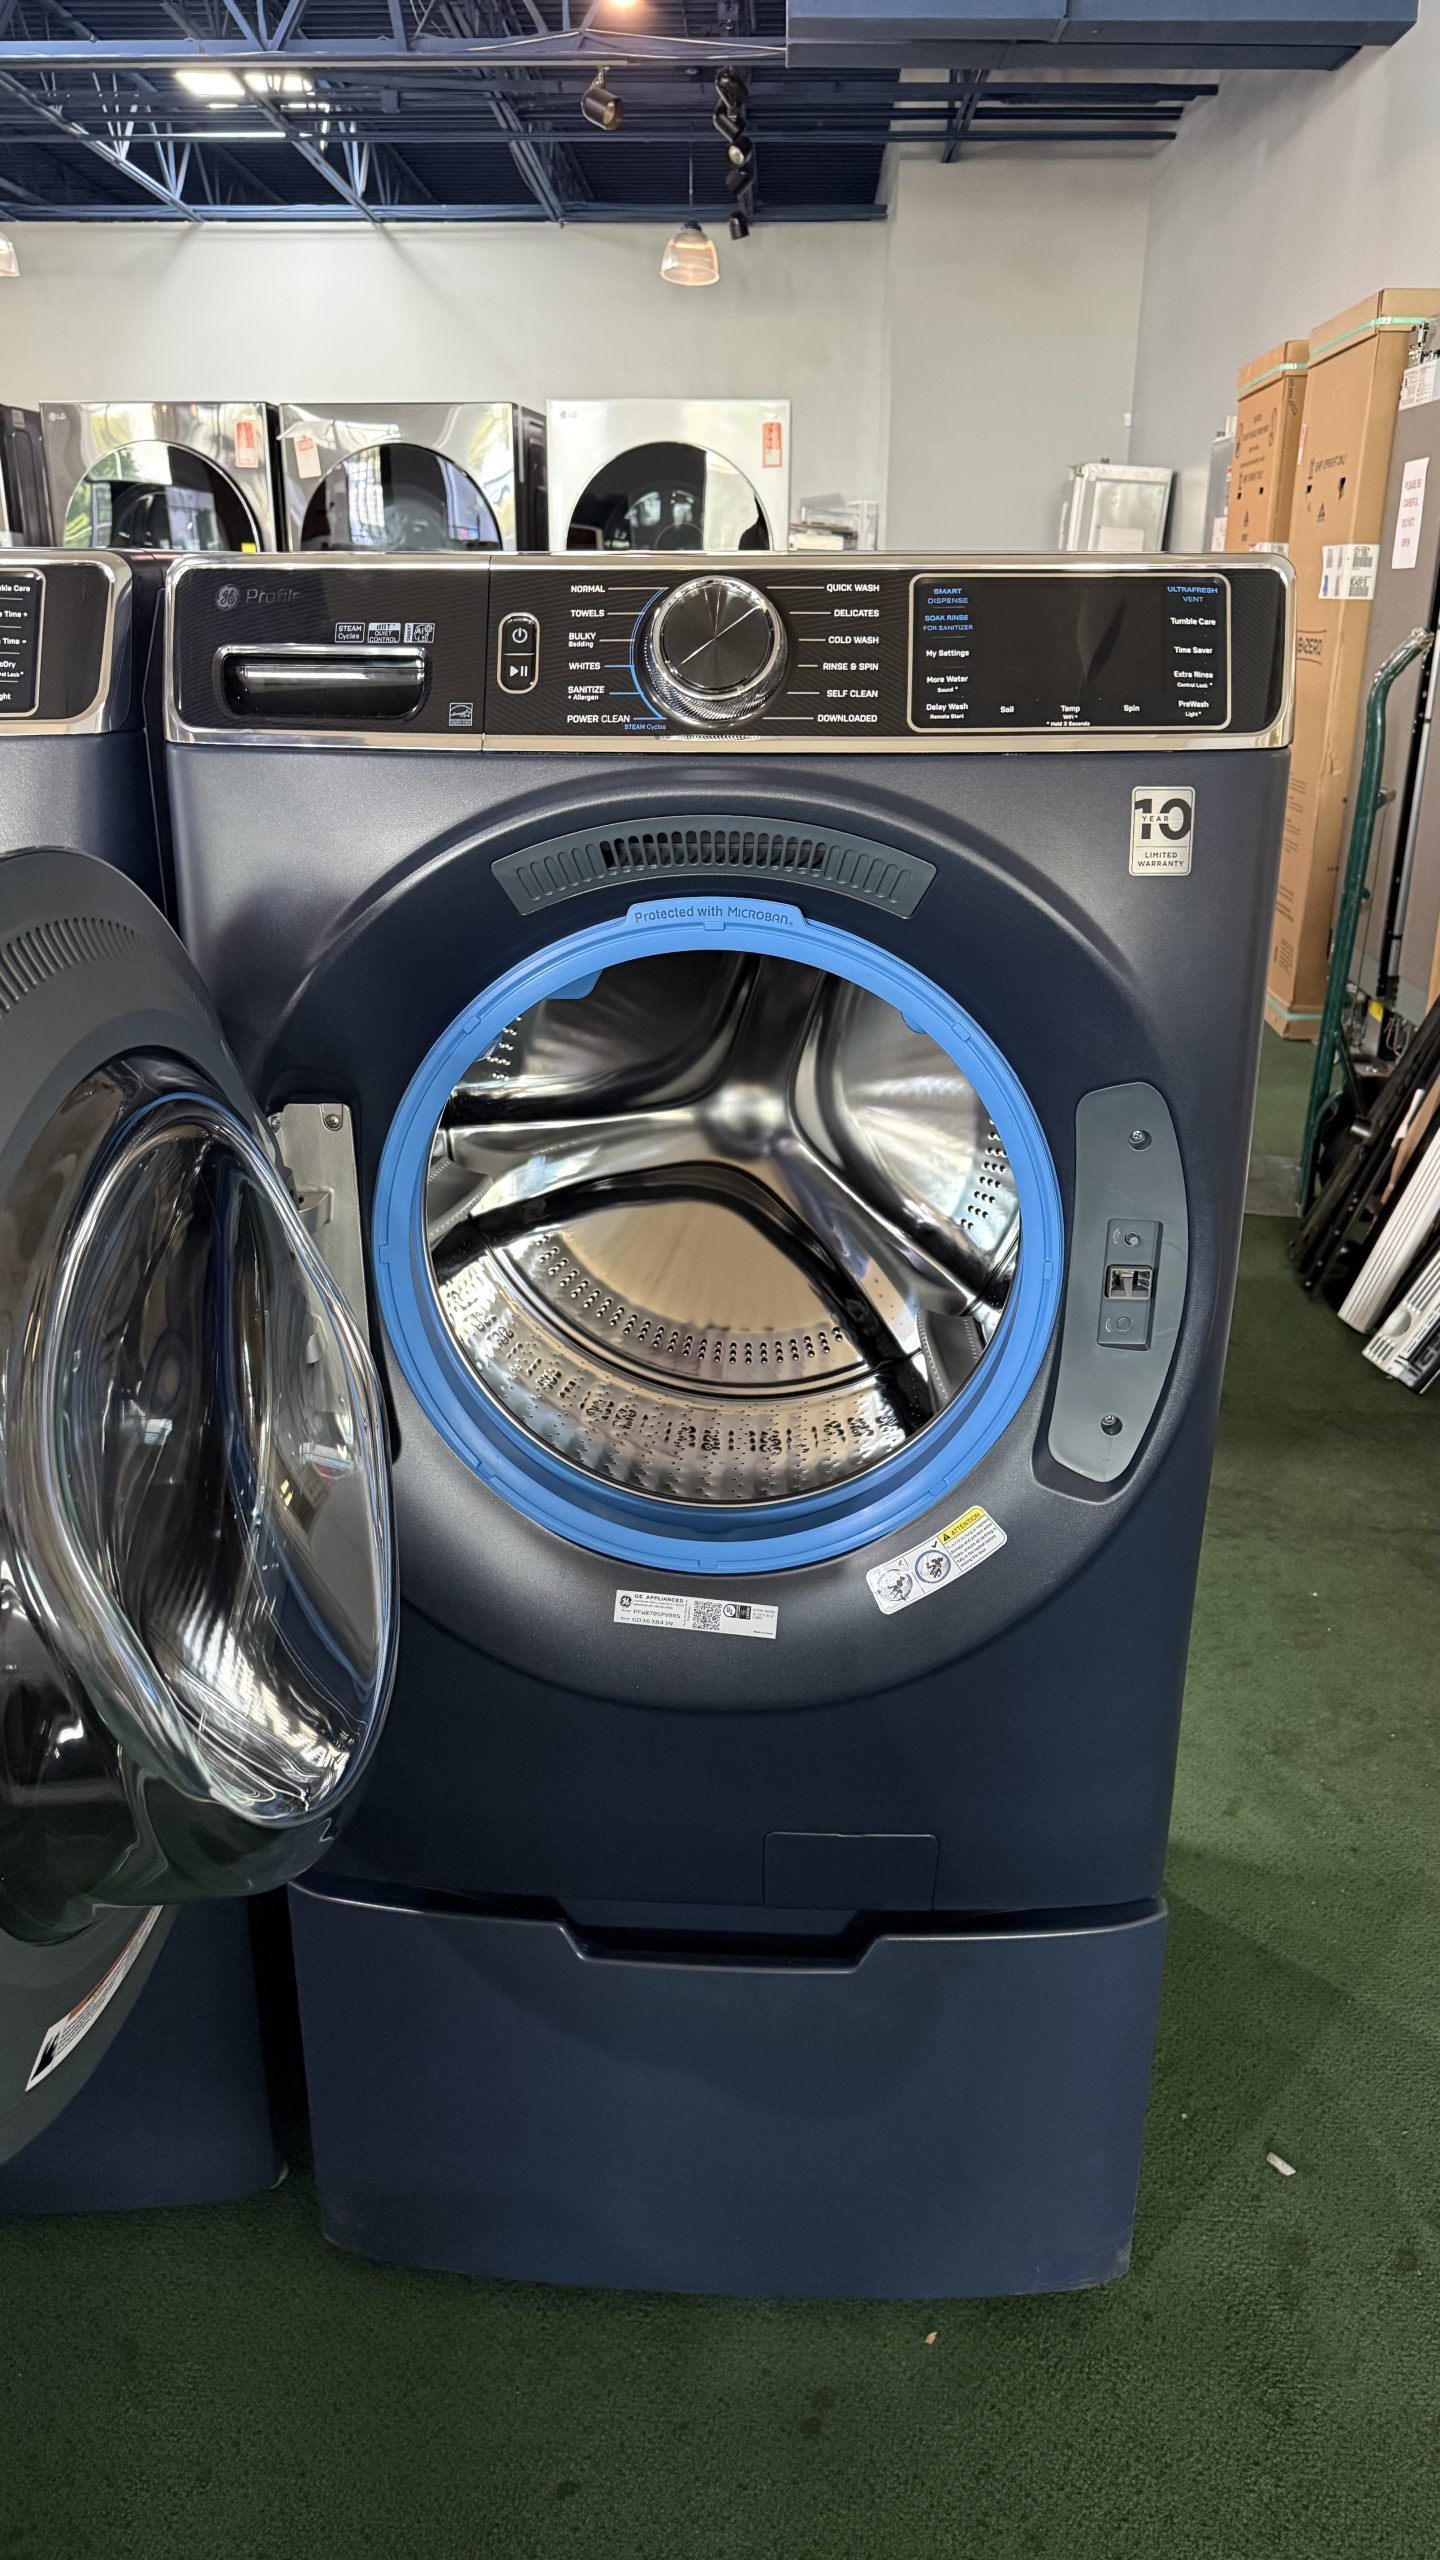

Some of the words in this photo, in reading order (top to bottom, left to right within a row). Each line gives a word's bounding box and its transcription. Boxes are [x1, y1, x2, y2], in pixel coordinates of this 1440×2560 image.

[570, 585, 605, 593] NORMAL
[826, 583, 852, 593] QUICK
[854, 583, 880, 592] WASH
[1167, 586, 1218, 594] ULTRAFRESH
[4, 610, 21, 618] Time
[570, 609, 605, 618] TOWELS
[833, 609, 880, 618] DELICATES
[924, 614, 946, 622] SOAK
[1170, 617, 1197, 625] Tumble
[1198, 617, 1217, 626] Care
[568, 632, 597, 640] BULKY
[828, 635, 852, 644] COLD
[853, 635, 880, 644] WASH
[2, 637, 20, 645] Time
[568, 640, 594, 649] Bedding
[925, 649, 937, 658] My
[938, 649, 970, 658] Settings
[1192, 646, 1213, 654] Saver
[568, 662, 601, 670] WHITES
[822, 662, 849, 671] RINSE
[850, 662, 857, 671] &
[858, 662, 879, 671] SPIN
[1173, 670, 1193, 678] Extra
[1193, 670, 1214, 679] Rinse
[926, 676, 945, 684] More
[945, 675, 969, 683] Water
[567, 685, 605, 694] SANITIZE
[826, 689, 848, 698] SELF
[849, 689, 879, 698] CLEAN
[573, 694, 599, 702] Allergen
[926, 703, 946, 712] Delay
[948, 702, 969, 711] Wash
[1060, 704, 1081, 713] Temp
[1123, 704, 1140, 713] Spin
[1178, 700, 1209, 708] PreWash
[1000, 705, 1015, 713] Soil
[566, 714, 599, 723] POWER
[601, 714, 631, 723] CLEAN
[817, 713, 878, 722] DOWNLOADED
[1134, 797, 1192, 841] 10
[1144, 851, 1178, 859] LIMITED
[634, 905, 694, 924] Protected
[697, 906, 723, 918] with
[951, 1512, 981, 1536] ATTENTION
